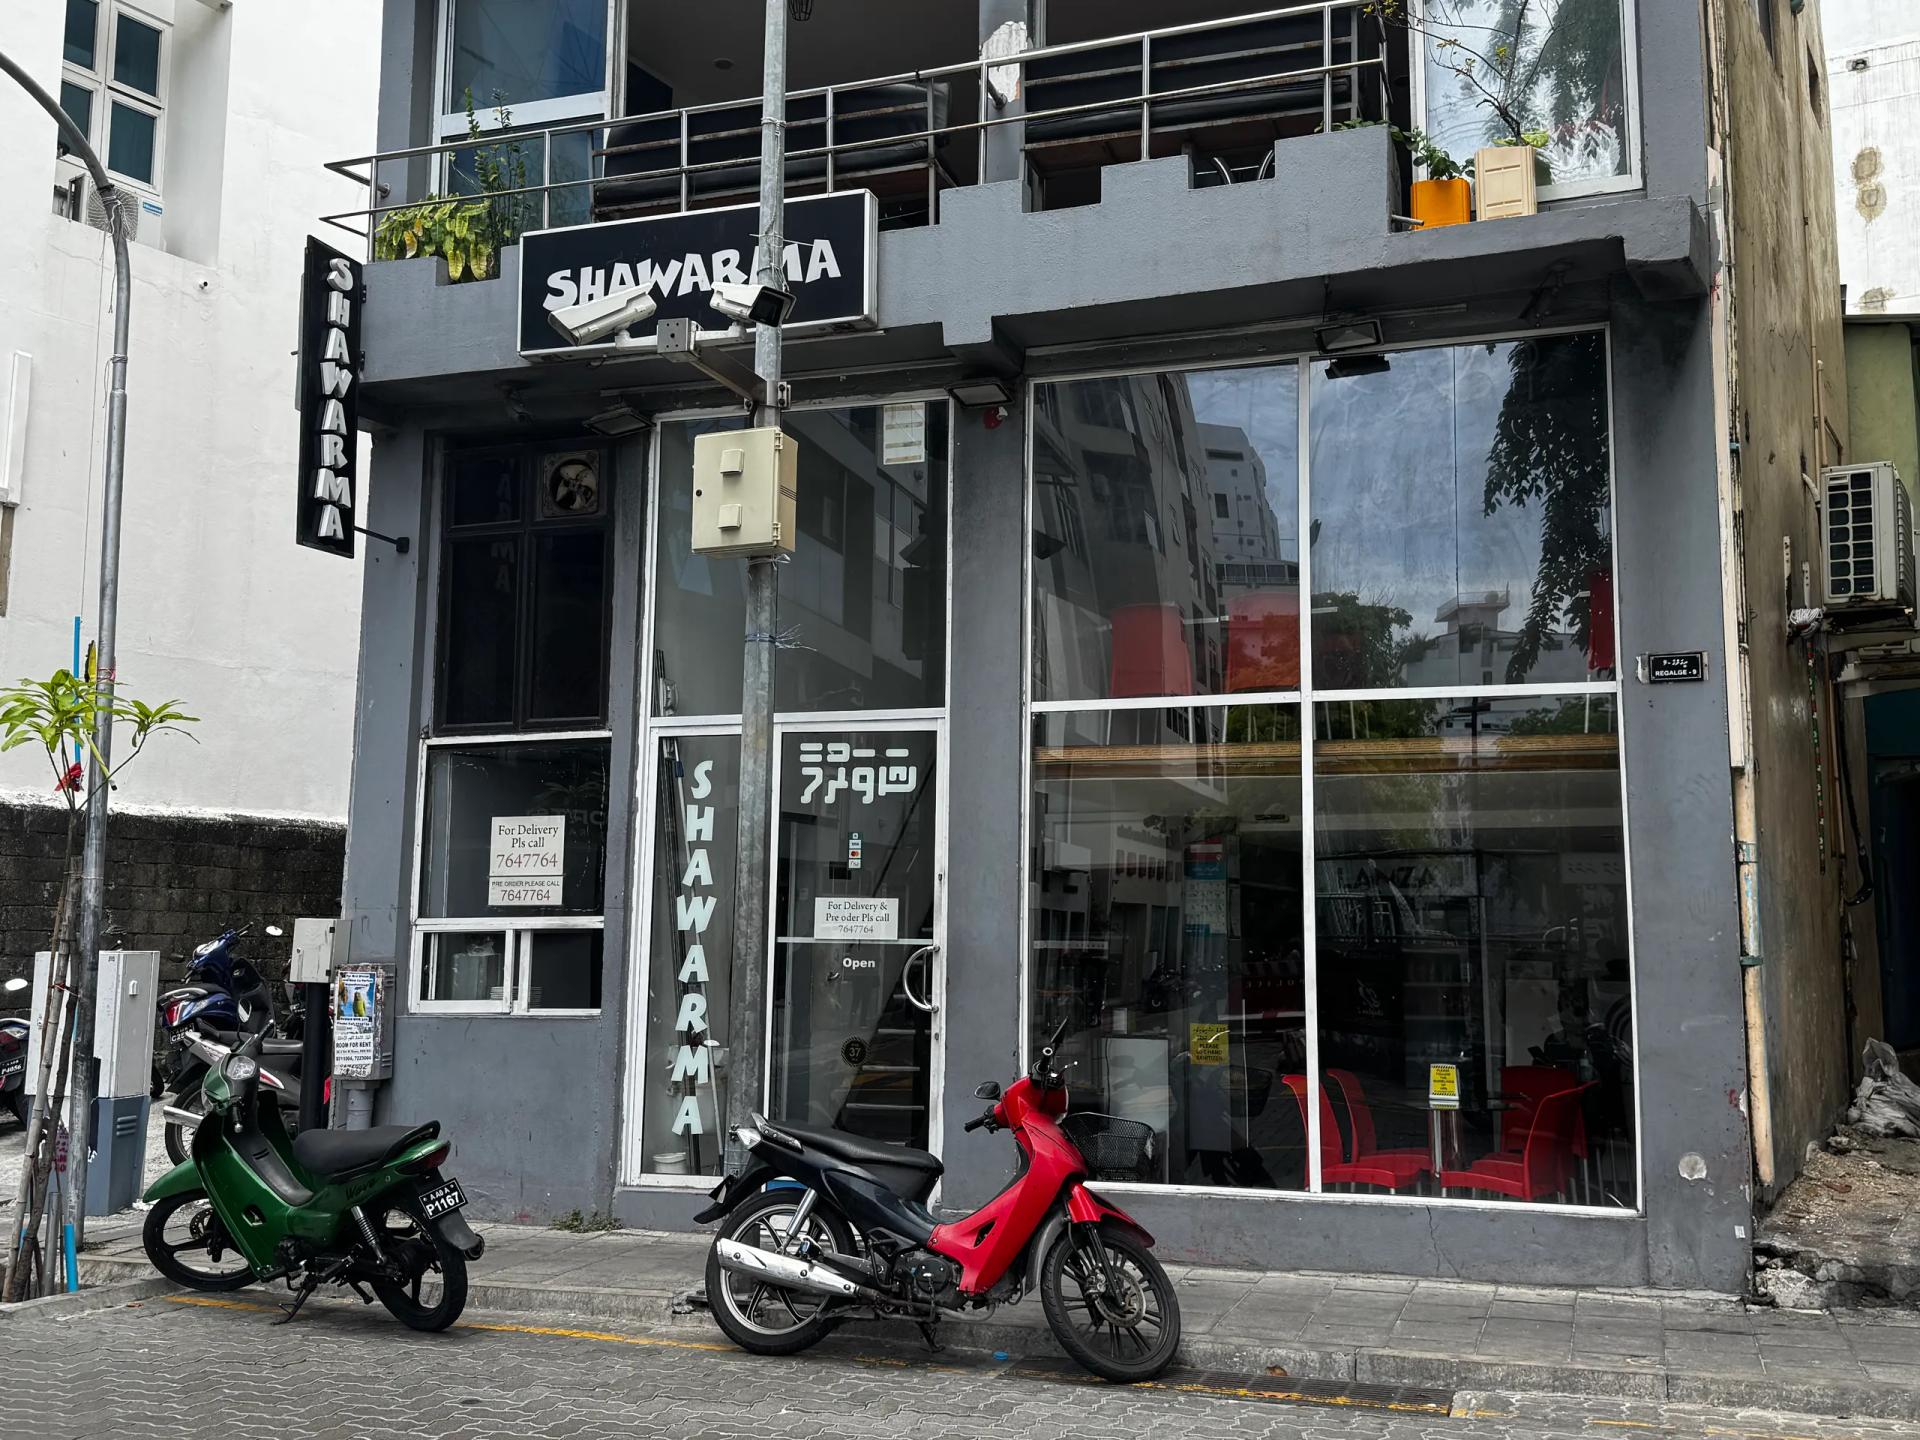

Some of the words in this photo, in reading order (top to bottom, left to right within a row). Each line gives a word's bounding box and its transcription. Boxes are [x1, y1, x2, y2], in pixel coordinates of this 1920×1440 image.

[314, 257, 354, 541] SHAWARMA
[498, 825, 516, 836] For
[518, 823, 559, 838] Delivery
[511, 837, 526, 848] Pls
[527, 836, 545, 848] call
[496, 852, 559, 868] 7647764
[500, 889, 551, 902] 7647764
[827, 901, 842, 910] For
[843, 901, 879, 912] Delivery
[879, 901, 888, 910] &
[825, 913, 840, 922] Pre
[840, 913, 860, 922] oder
[861, 913, 874, 922] Pls
[875, 913, 890, 922] call
[838, 925, 874, 934] 7647764
[670, 759, 718, 1136] SHAWARMA
[842, 957, 876, 970] Open
[425, 1191, 460, 1216] P1167
